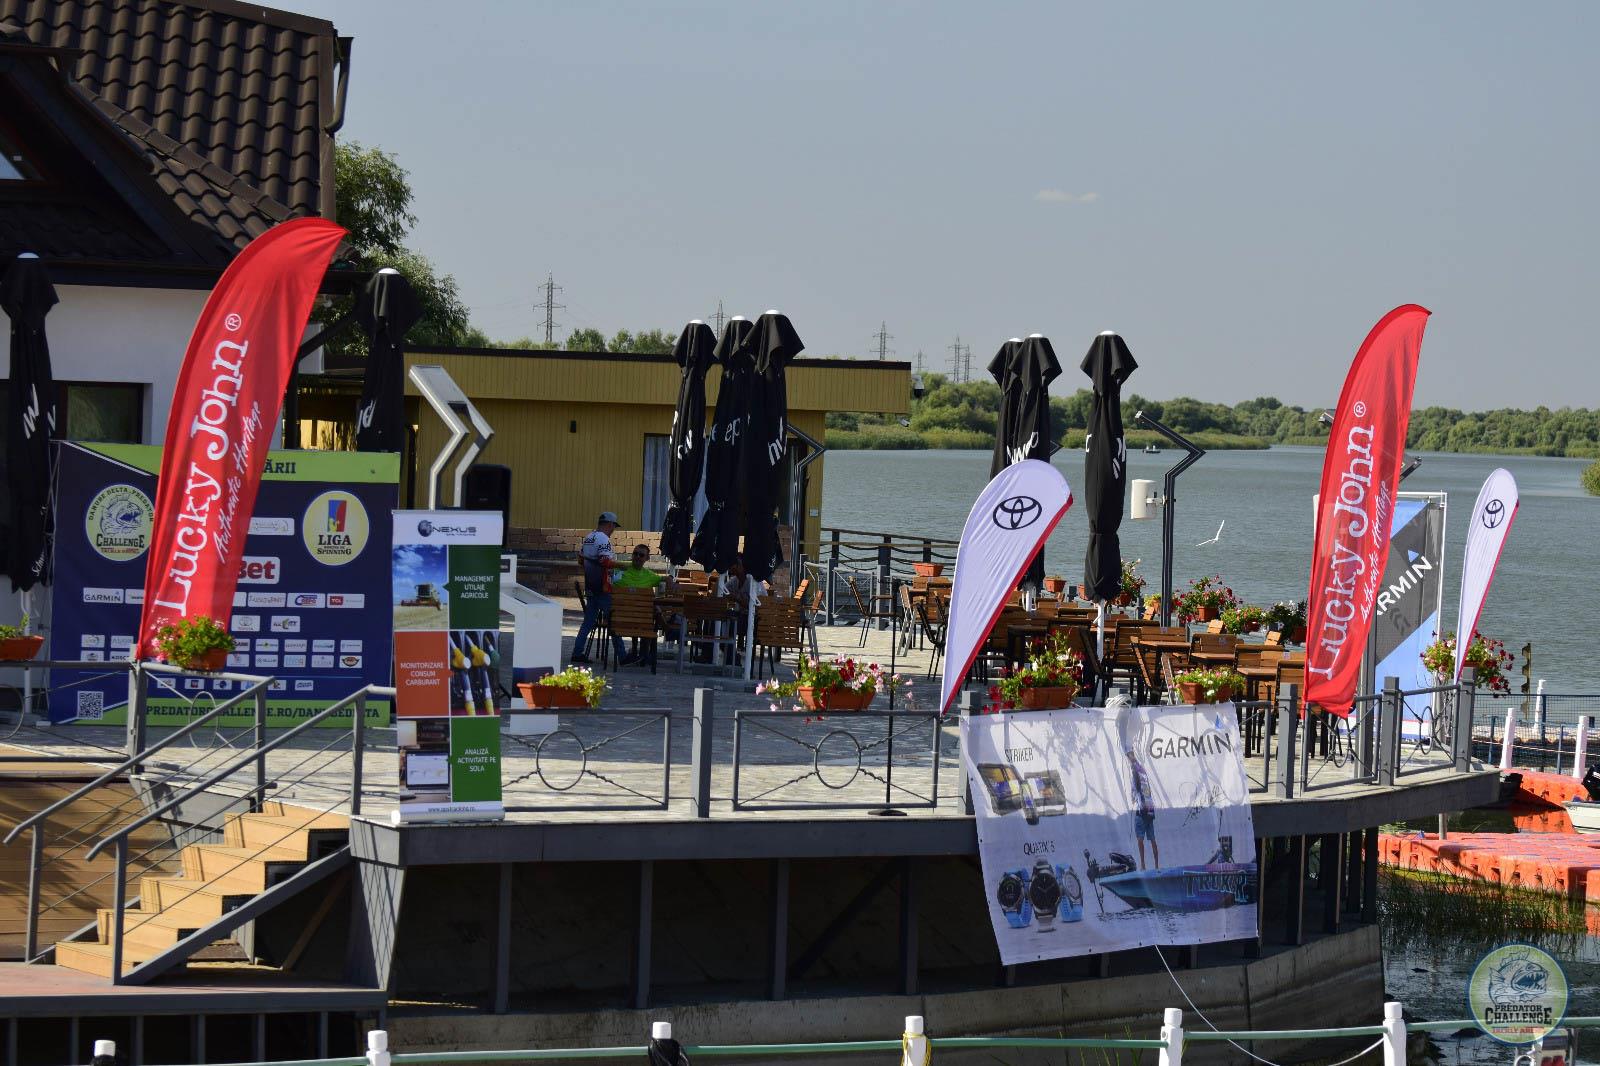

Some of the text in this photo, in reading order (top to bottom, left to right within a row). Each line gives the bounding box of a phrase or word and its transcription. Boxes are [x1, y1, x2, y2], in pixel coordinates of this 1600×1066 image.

[154, 462, 222, 617] Lucky
[190, 340, 249, 461] John
[213, 401, 262, 564] Authentic Heritage
[1333, 424, 1375, 538] John
[318, 534, 352, 546] LIGA
[317, 547, 352, 555] SPINNING
[464, 583, 486, 591] UTILAJE
[1377, 555, 1433, 616] RMIN
[85, 594, 120, 602] GARMIN
[1308, 539, 1365, 680] Lucky
[405, 678, 441, 686] CARBURANT
[410, 670, 436, 678] CONSUM
[1150, 733, 1232, 760] GARMIN
[1004, 747, 1034, 763] STRIKER
